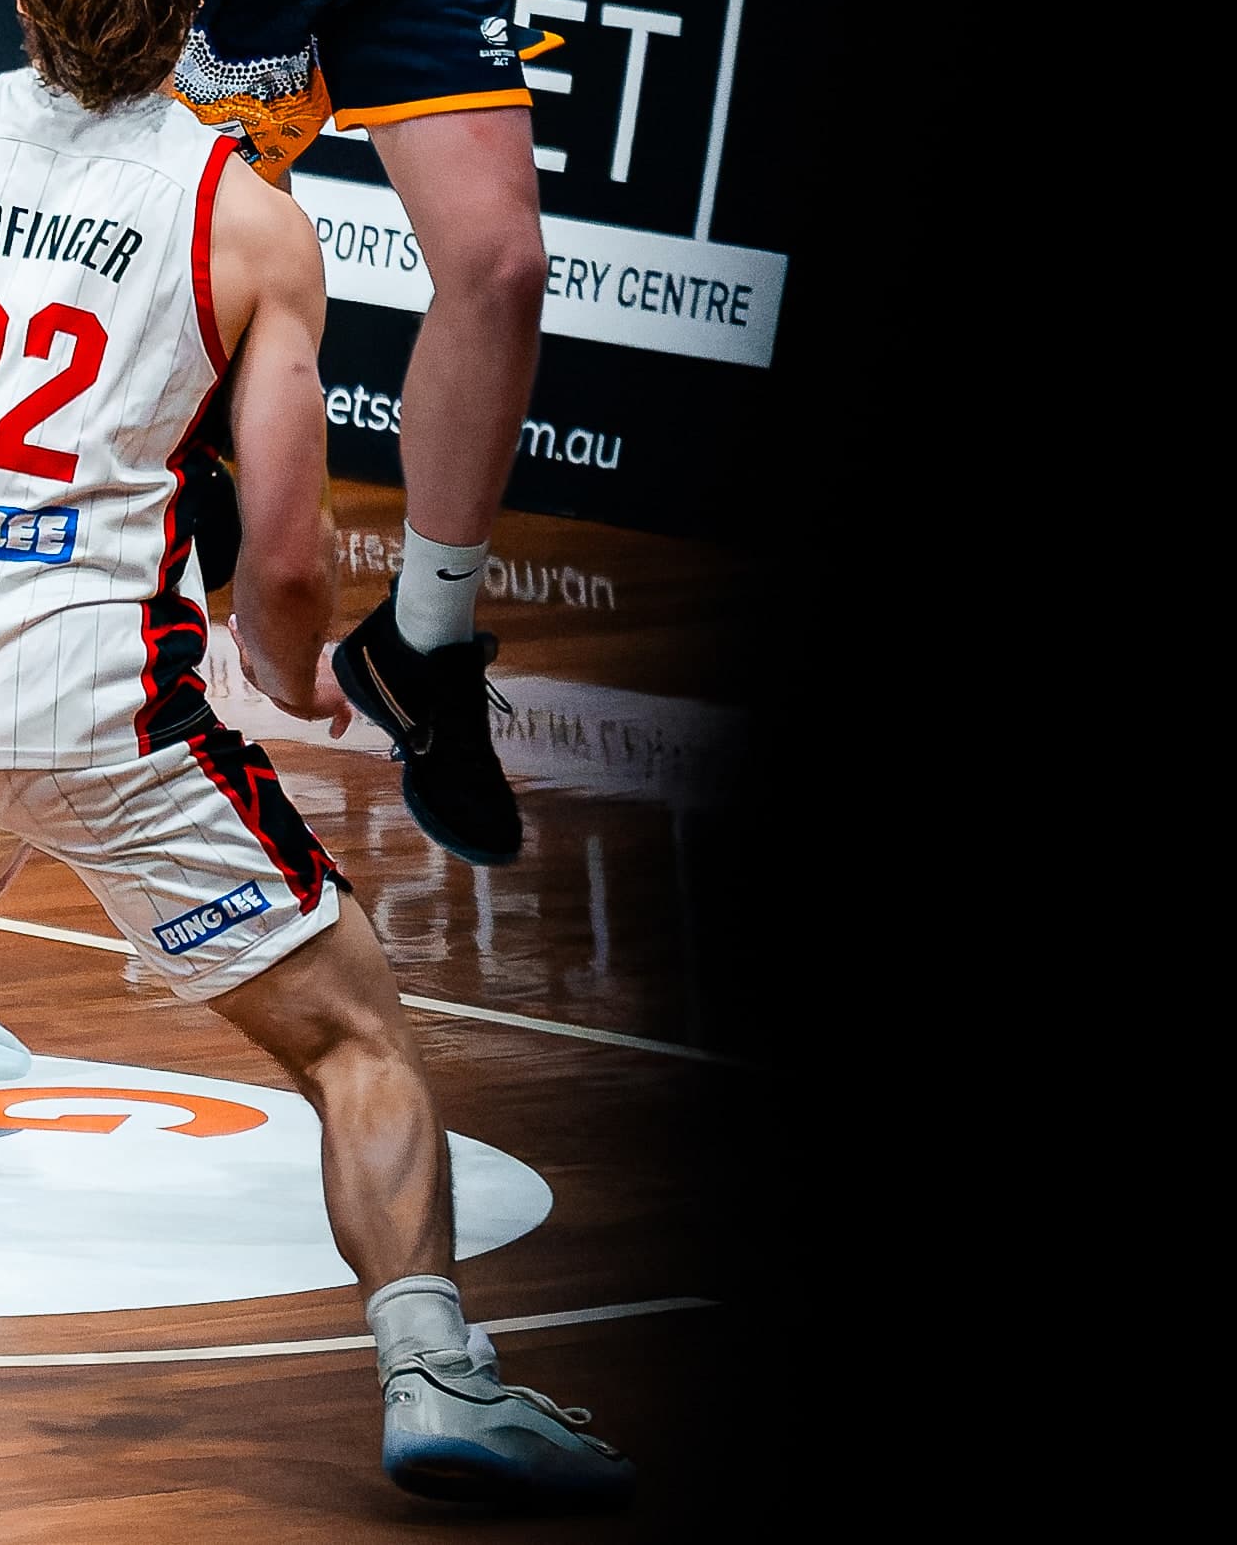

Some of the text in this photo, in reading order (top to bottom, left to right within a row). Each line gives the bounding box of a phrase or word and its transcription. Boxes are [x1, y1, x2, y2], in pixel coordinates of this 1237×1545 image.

[617, 266, 754, 328] CENTRE
[159, 886, 263, 950] BING LEE
